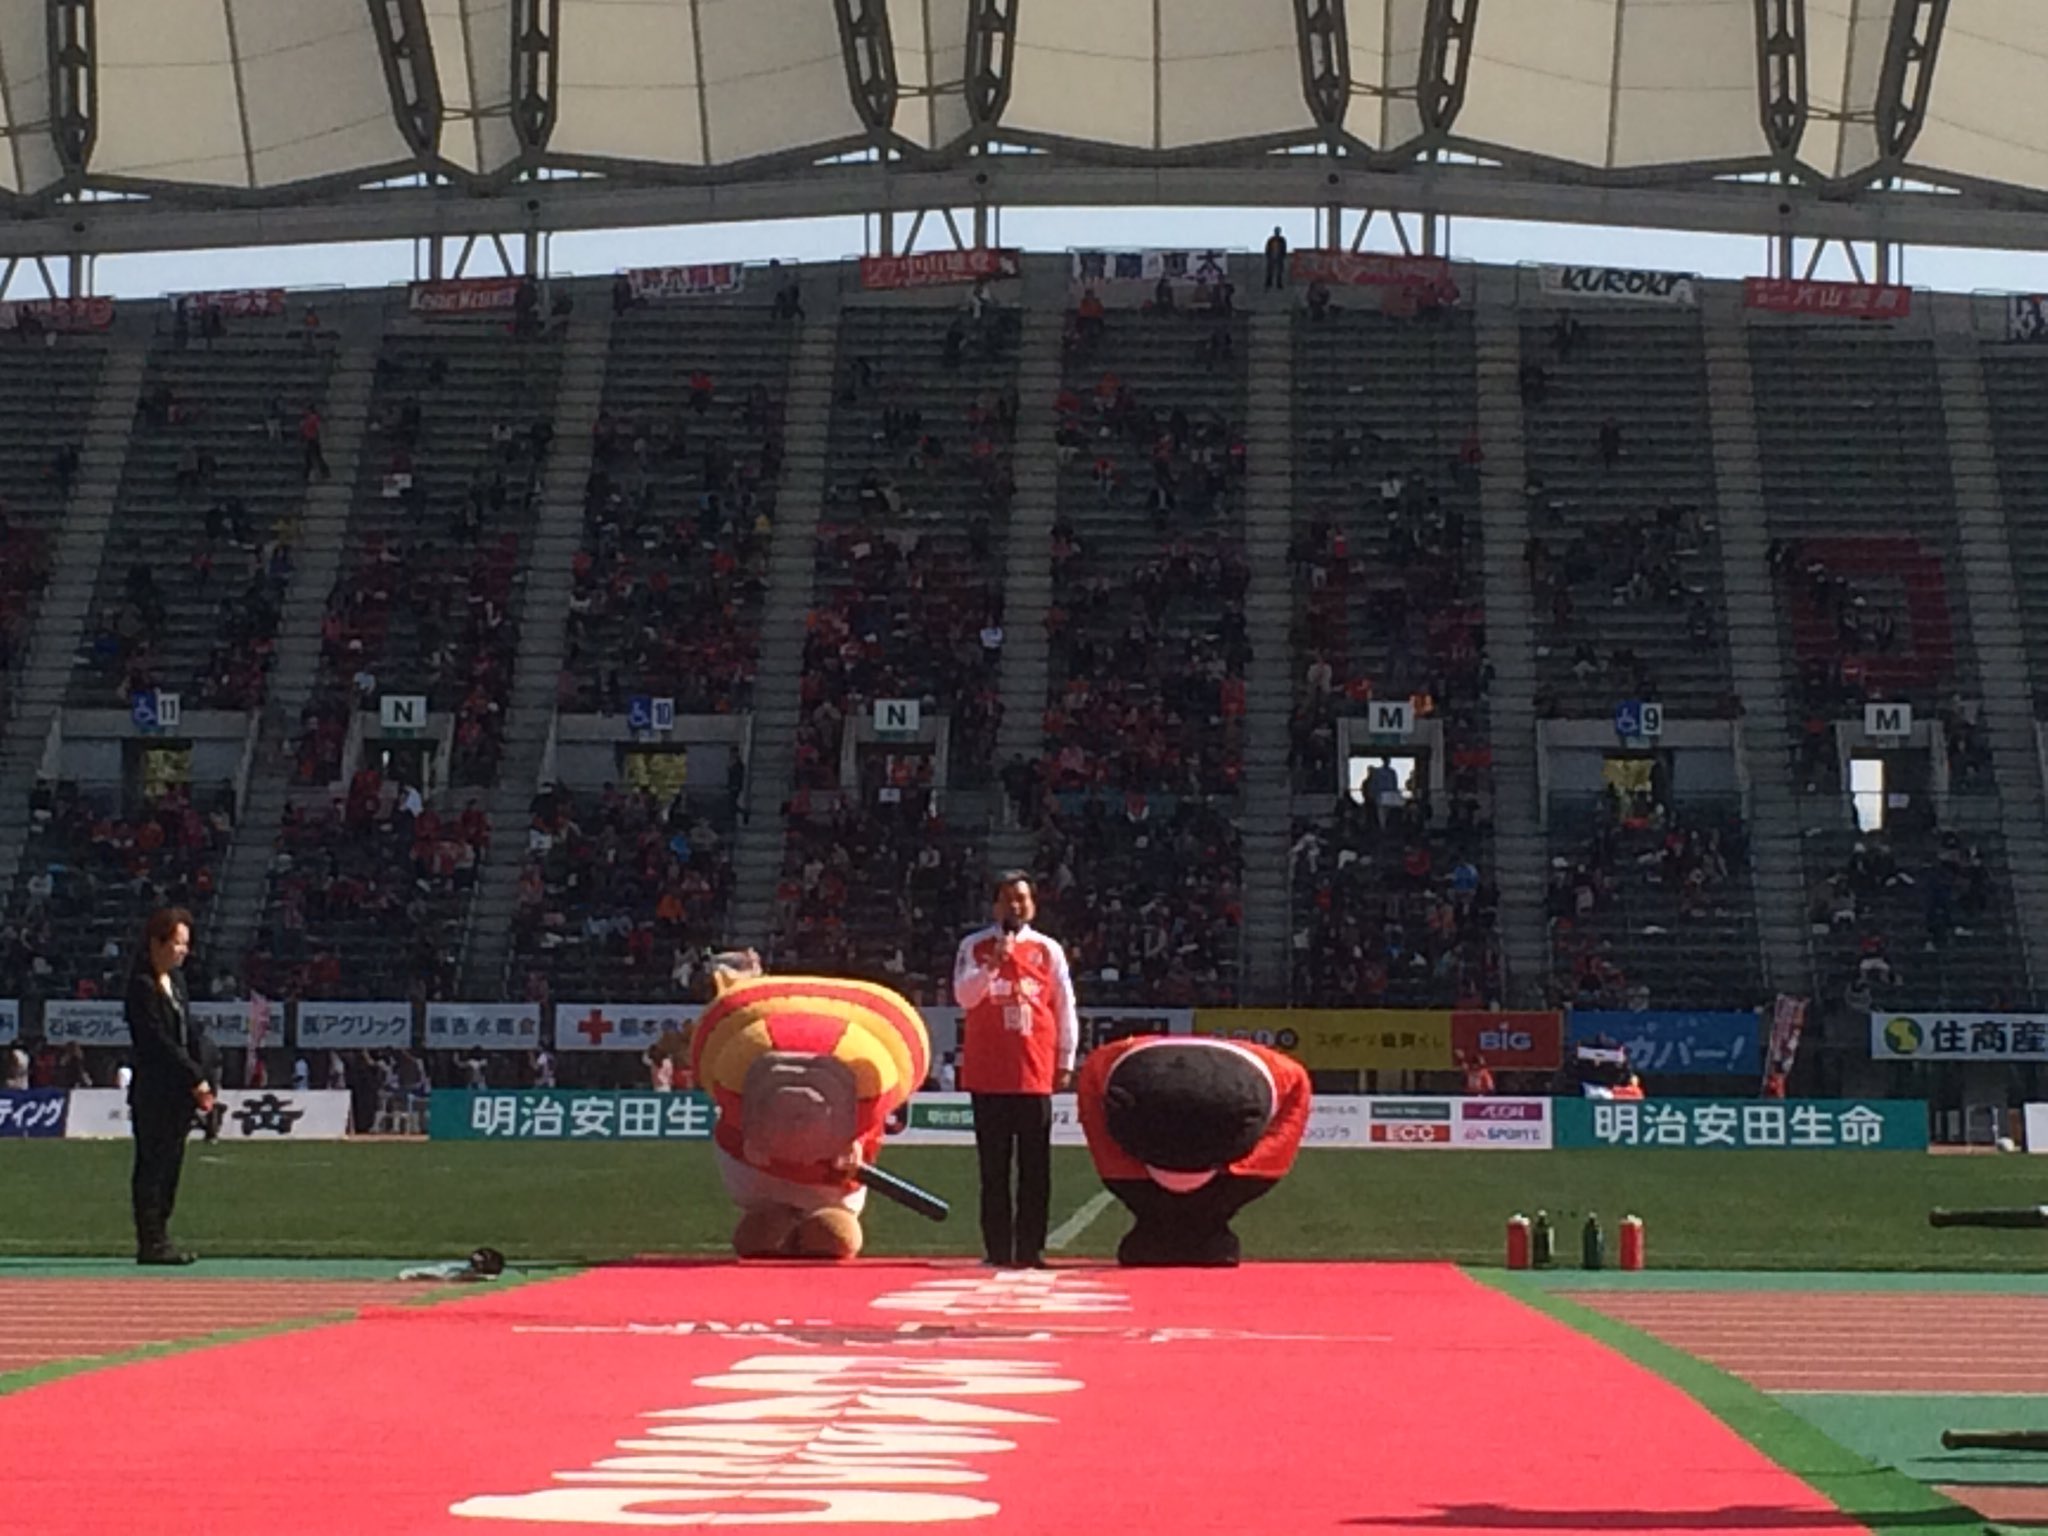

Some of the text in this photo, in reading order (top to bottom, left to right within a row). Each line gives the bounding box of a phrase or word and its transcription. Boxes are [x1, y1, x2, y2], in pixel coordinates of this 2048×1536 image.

[159, 699, 176, 720] 11
[392, 700, 414, 722] N
[655, 702, 671, 725] 10
[887, 704, 906, 726] N
[1378, 706, 1403, 729] M
[1644, 707, 1660, 731] 9
[1875, 709, 1901, 732] M
[471, 1095, 722, 1137] 明治安田生
[1594, 1103, 1885, 1146] 明治安田生命
